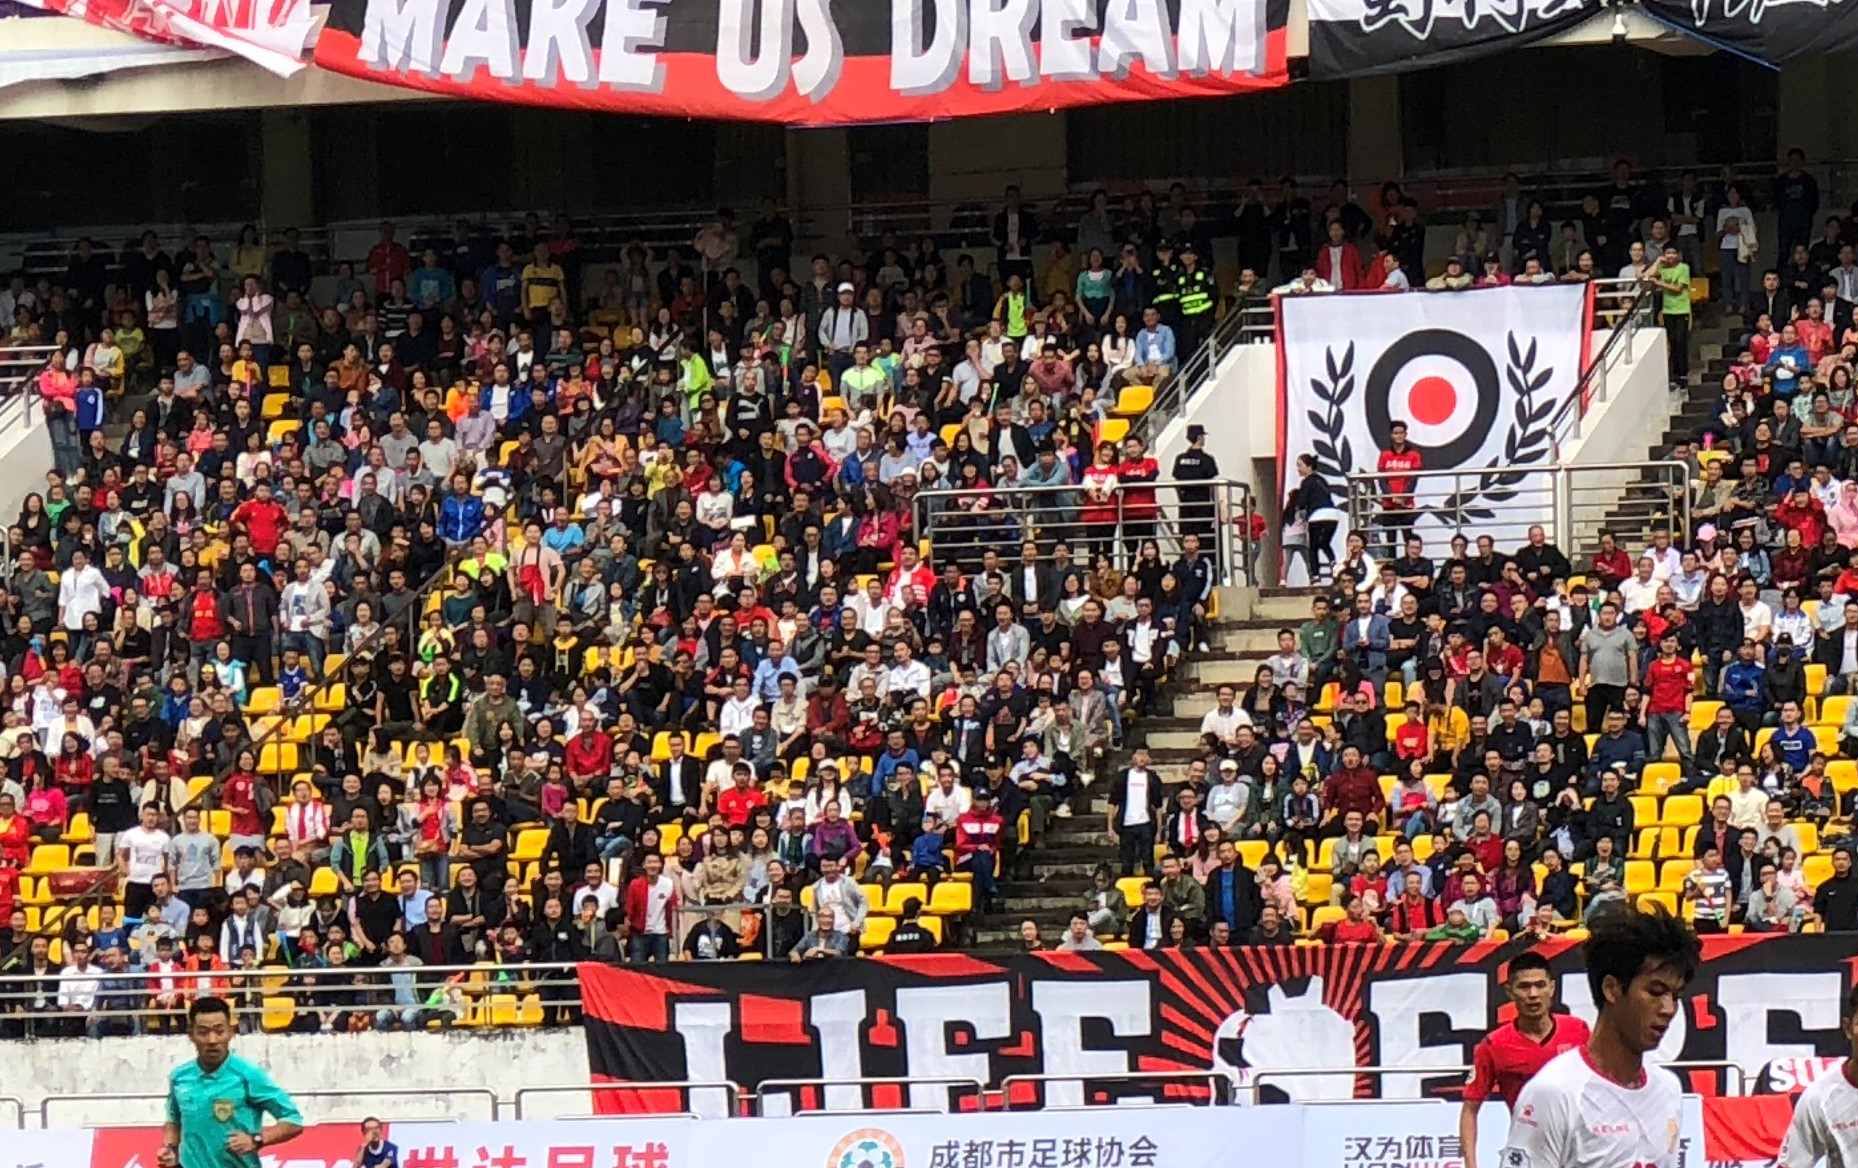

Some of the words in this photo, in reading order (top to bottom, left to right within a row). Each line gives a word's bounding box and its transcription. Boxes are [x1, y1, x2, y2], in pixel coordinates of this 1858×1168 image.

[357, 0, 668, 94] MAKE
[890, 0, 1268, 95] DREAM
[675, 980, 1152, 1117] LIFE
[1344, 1135, 1465, 1161] 汉为体育
